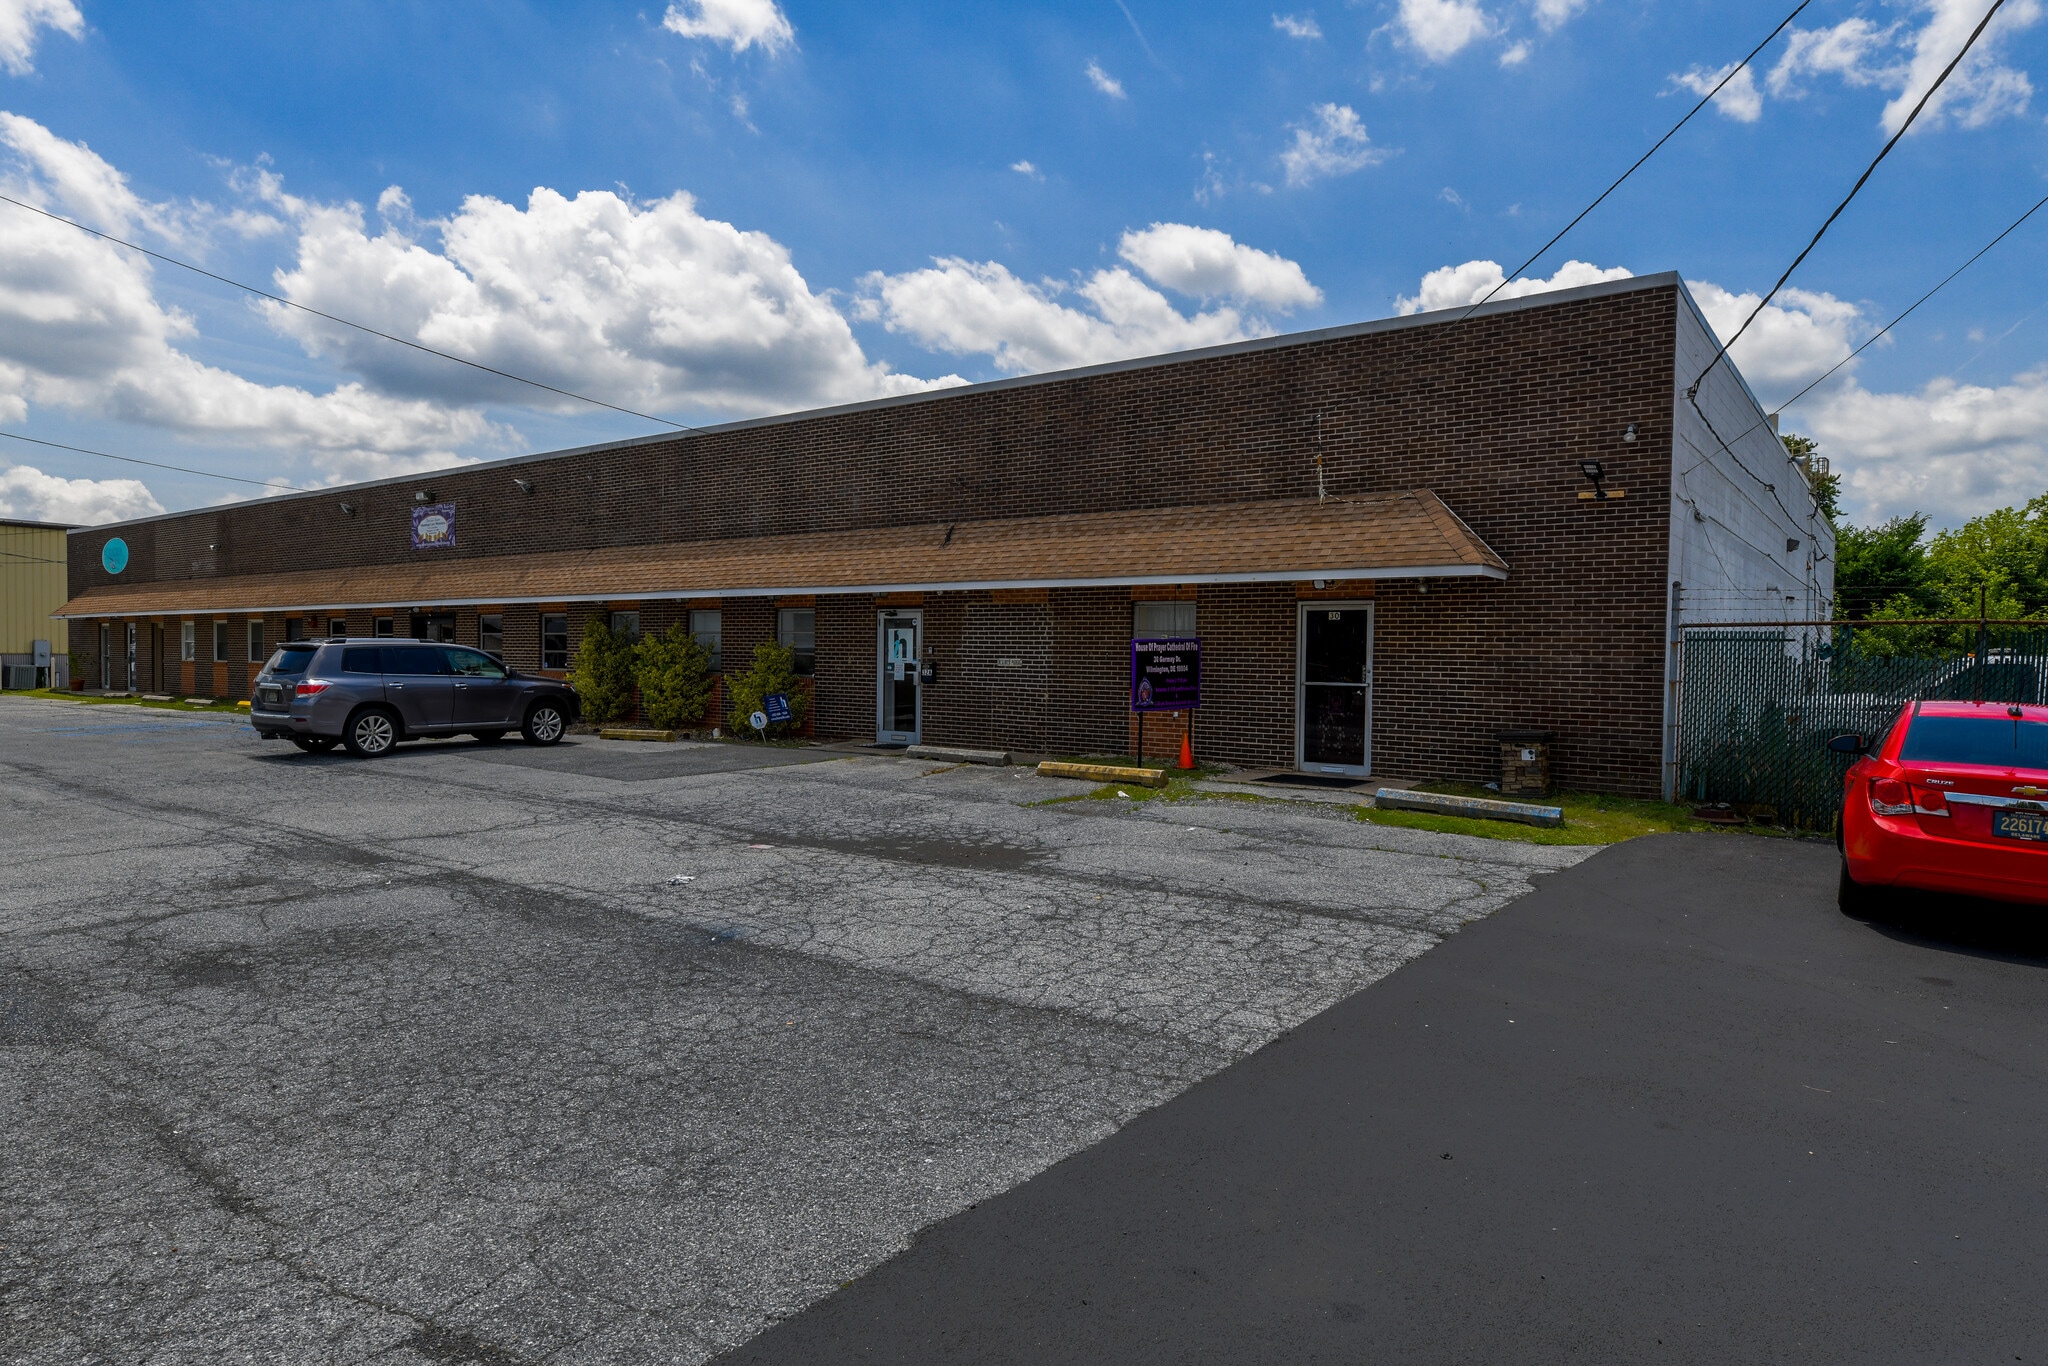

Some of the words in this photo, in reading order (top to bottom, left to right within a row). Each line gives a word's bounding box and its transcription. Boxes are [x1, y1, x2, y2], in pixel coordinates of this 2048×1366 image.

[1330, 612, 1340, 620] 30
[1135, 642, 1148, 651] House
[1149, 642, 1154, 651] Of
[1154, 642, 1166, 653] Prayer
[1167, 642, 1185, 651] Cathedral
[1186, 642, 1190, 651] Of
[1926, 778, 1954, 786] CRUZE
[2001, 817, 2048, 834] 226174
